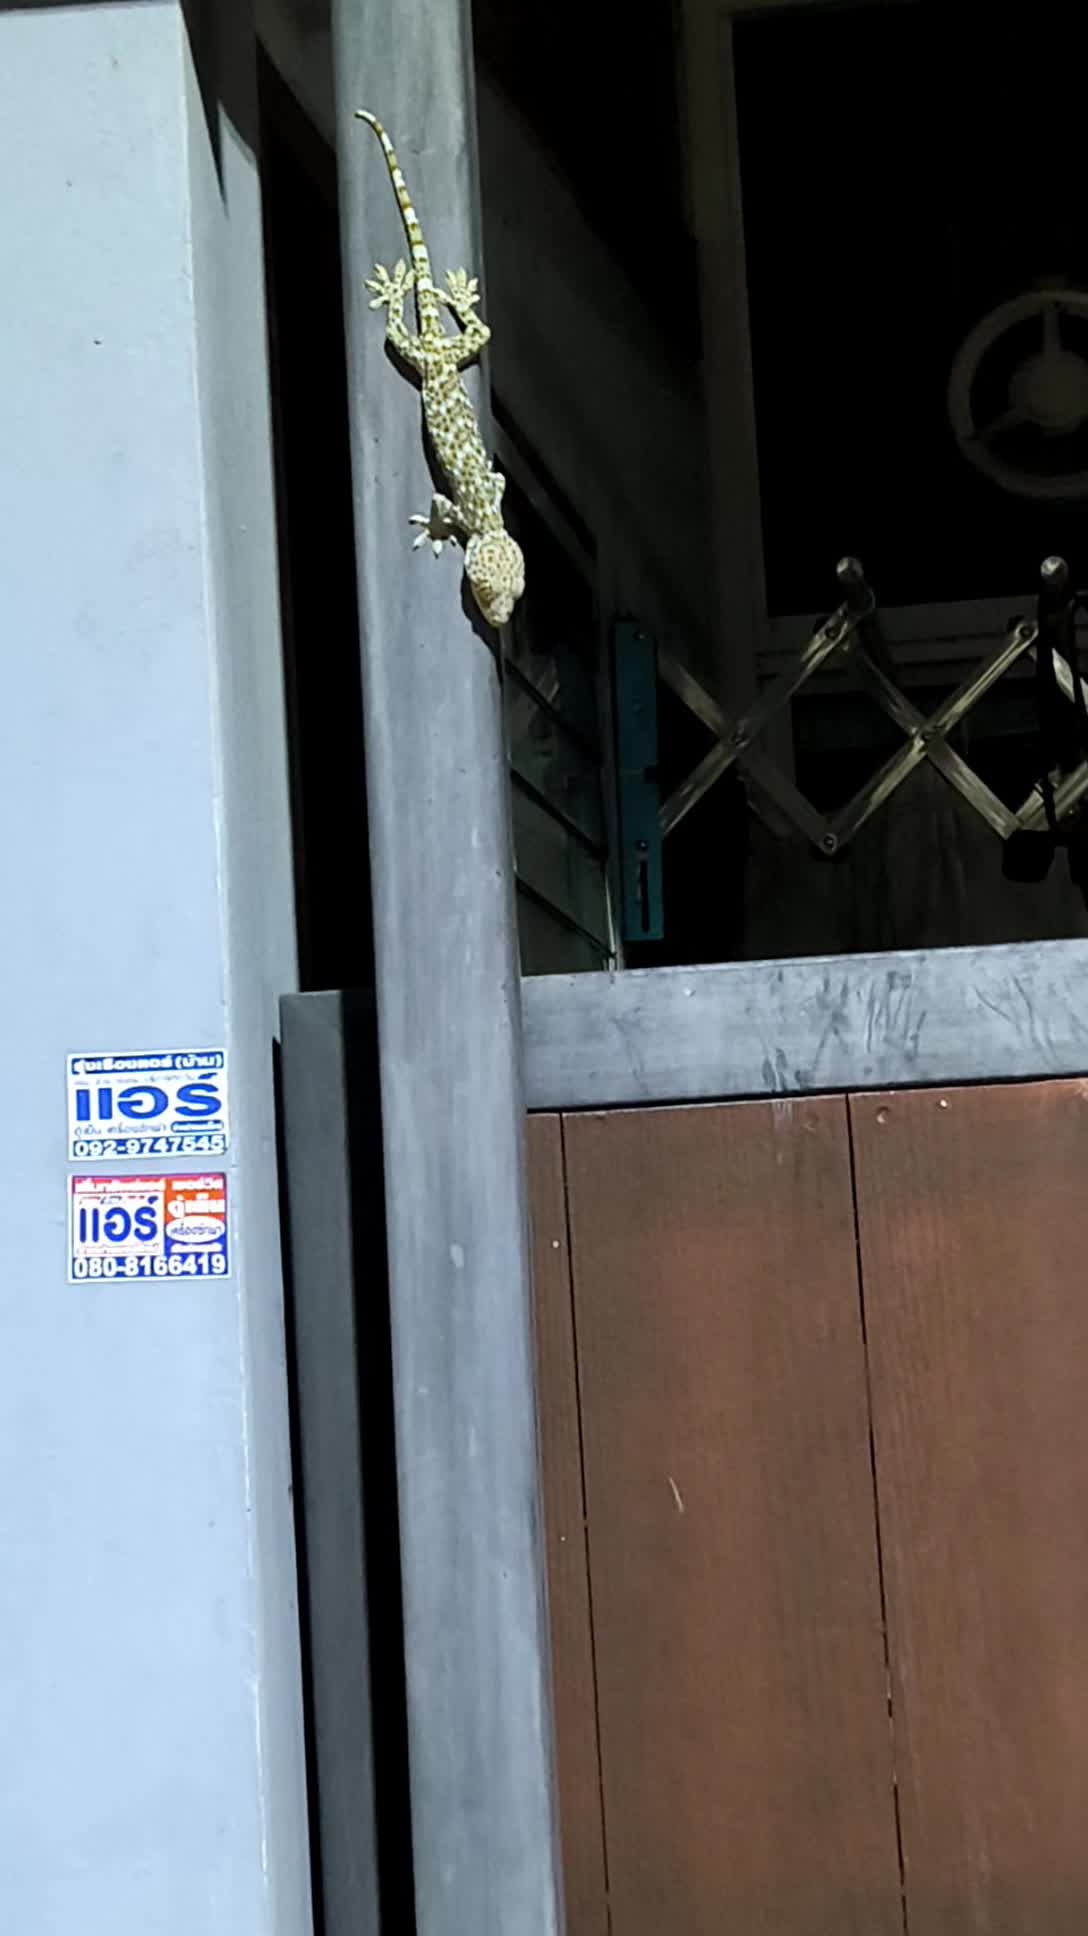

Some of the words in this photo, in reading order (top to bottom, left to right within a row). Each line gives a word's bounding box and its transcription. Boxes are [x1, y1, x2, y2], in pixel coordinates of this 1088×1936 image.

[76, 1072, 222, 1120] แอร์
[74, 1136, 225, 1157] 092-9747545
[80, 1196, 159, 1243] แอร์
[73, 1254, 226, 1278] 080-8166419
